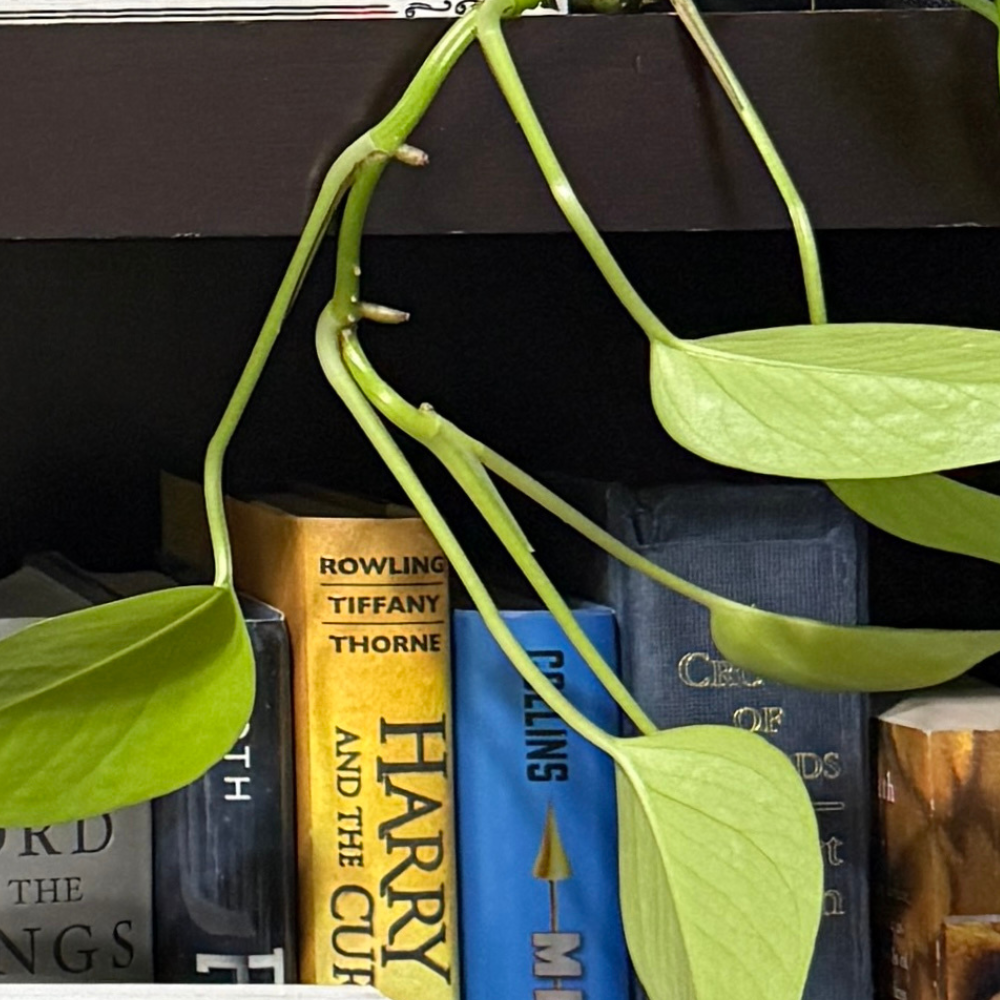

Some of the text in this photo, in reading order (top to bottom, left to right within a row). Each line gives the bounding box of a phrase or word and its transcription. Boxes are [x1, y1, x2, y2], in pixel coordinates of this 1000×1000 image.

[319, 556, 445, 576] ROWLING
[327, 594, 441, 615] TIFFANY
[328, 633, 442, 654] THORNE
[733, 706, 784, 734] OF
[335, 725, 362, 798] AND
[337, 806, 364, 868] THE
[376, 713, 452, 986] HARRY
[8, 876, 85, 905] THE
